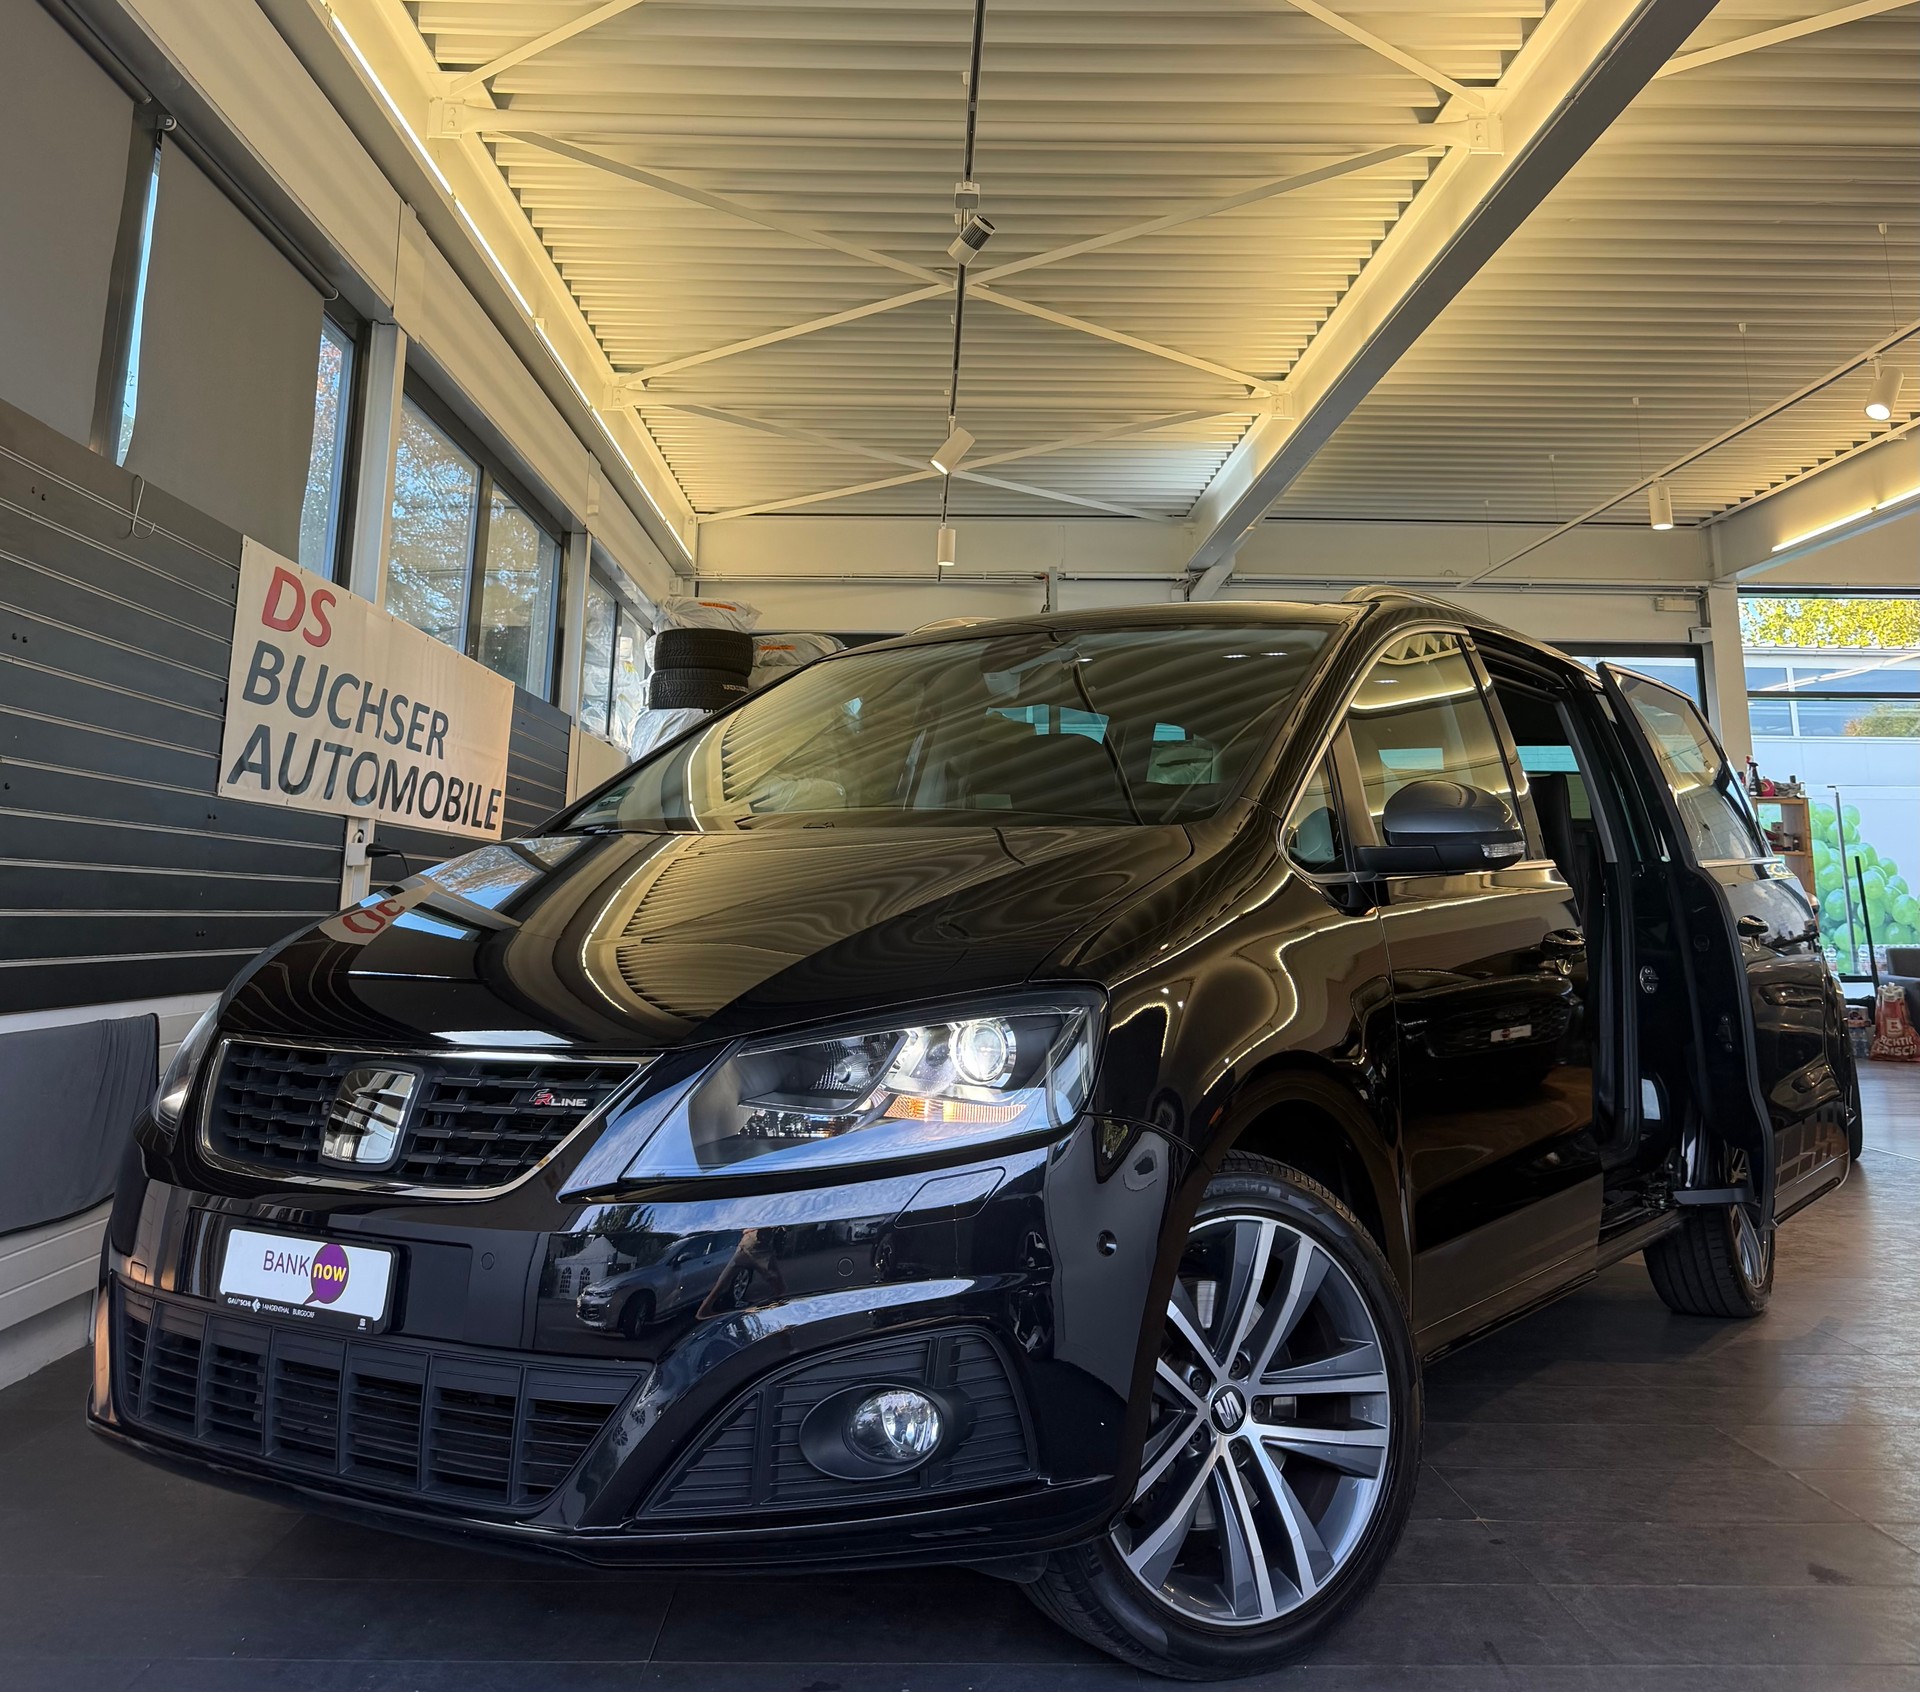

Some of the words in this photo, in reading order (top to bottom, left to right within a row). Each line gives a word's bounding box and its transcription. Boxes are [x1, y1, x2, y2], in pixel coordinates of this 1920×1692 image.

[261, 566, 337, 647] DS
[242, 639, 449, 760] BUCHSER
[226, 723, 502, 830] AUTOMOBILE
[263, 1250, 311, 1277] BANK
[313, 1262, 347, 1283] now
